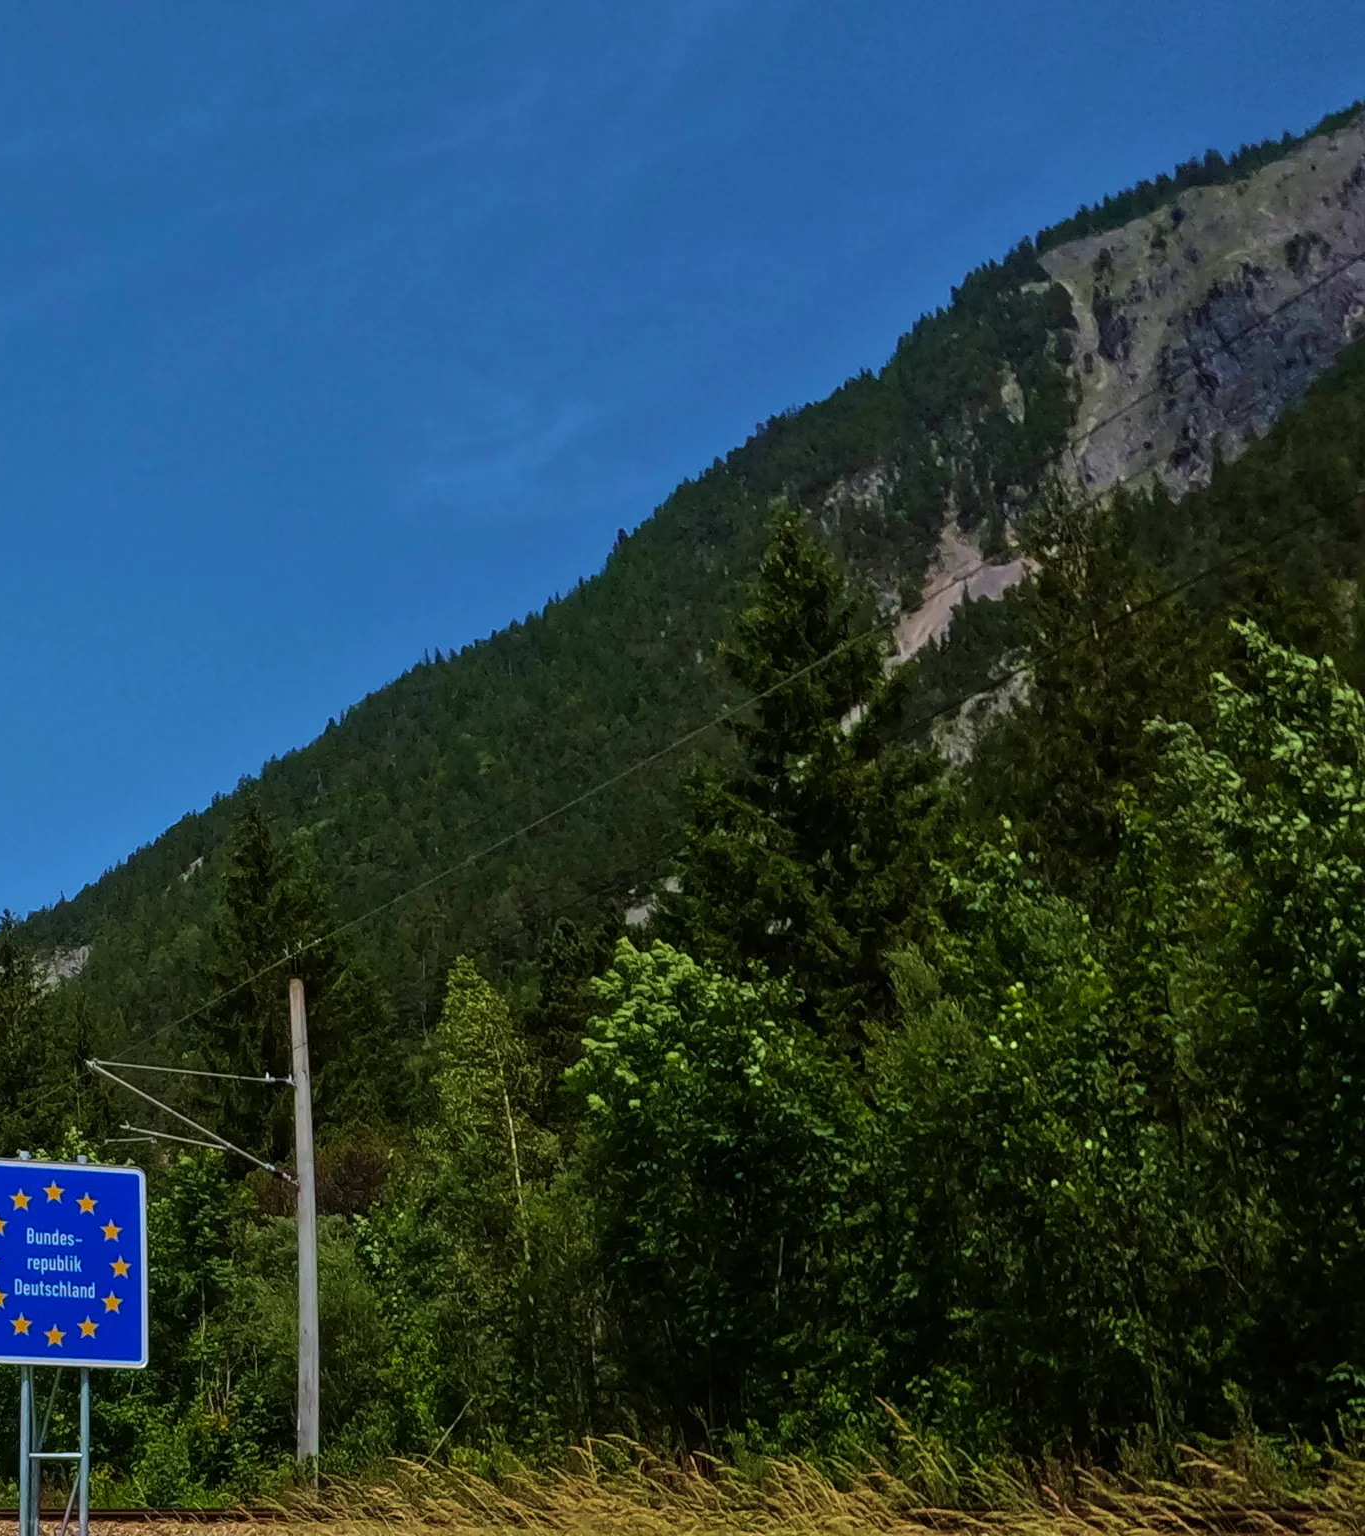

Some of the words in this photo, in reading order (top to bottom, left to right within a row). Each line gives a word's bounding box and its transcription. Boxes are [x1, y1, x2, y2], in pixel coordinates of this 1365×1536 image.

[26, 1227, 83, 1246] Bundes-
[27, 1254, 82, 1275] republik
[14, 1278, 95, 1299] Deutschland
